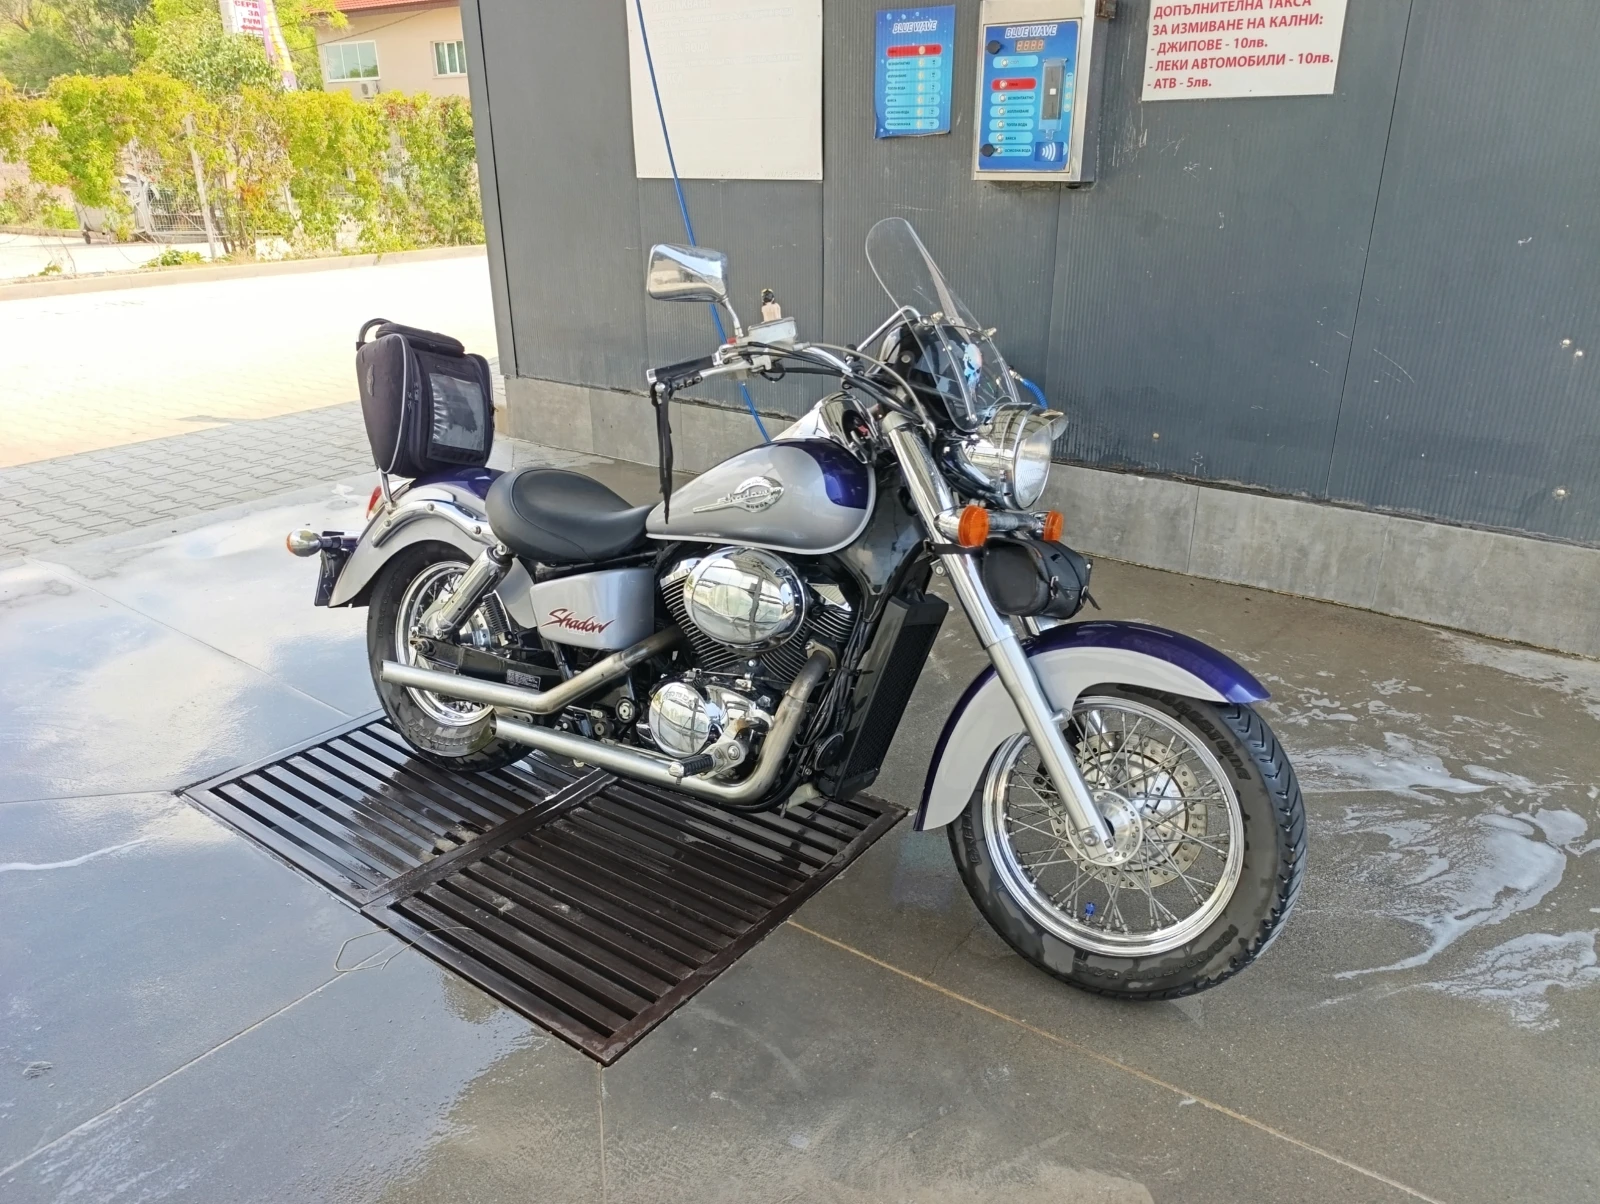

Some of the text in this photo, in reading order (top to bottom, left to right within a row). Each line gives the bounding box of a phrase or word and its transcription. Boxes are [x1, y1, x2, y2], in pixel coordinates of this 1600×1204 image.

[1154, 0, 1264, 20] ДОПЪЛНИТЕЛНА
[892, 20, 938, 34] BLUE WAVE
[1004, 24, 1058, 39] BLUE WAVE
[1152, 13, 1324, 36] ЗА ИЗМИВАНЕ НА КАЛНИ:
[1156, 38, 1222, 56] ДЖИПОВЕ
[1233, 37, 1268, 50] 10лв.
[1155, 59, 1188, 72] ЛЕКИ
[1191, 53, 1286, 70] АВТОМОБИЛИ
[1297, 52, 1334, 65] 10лв.
[1153, 77, 1177, 90] АТВ
[1186, 77, 1212, 88] 5лв.
[540, 608, 617, 634] Shadow
